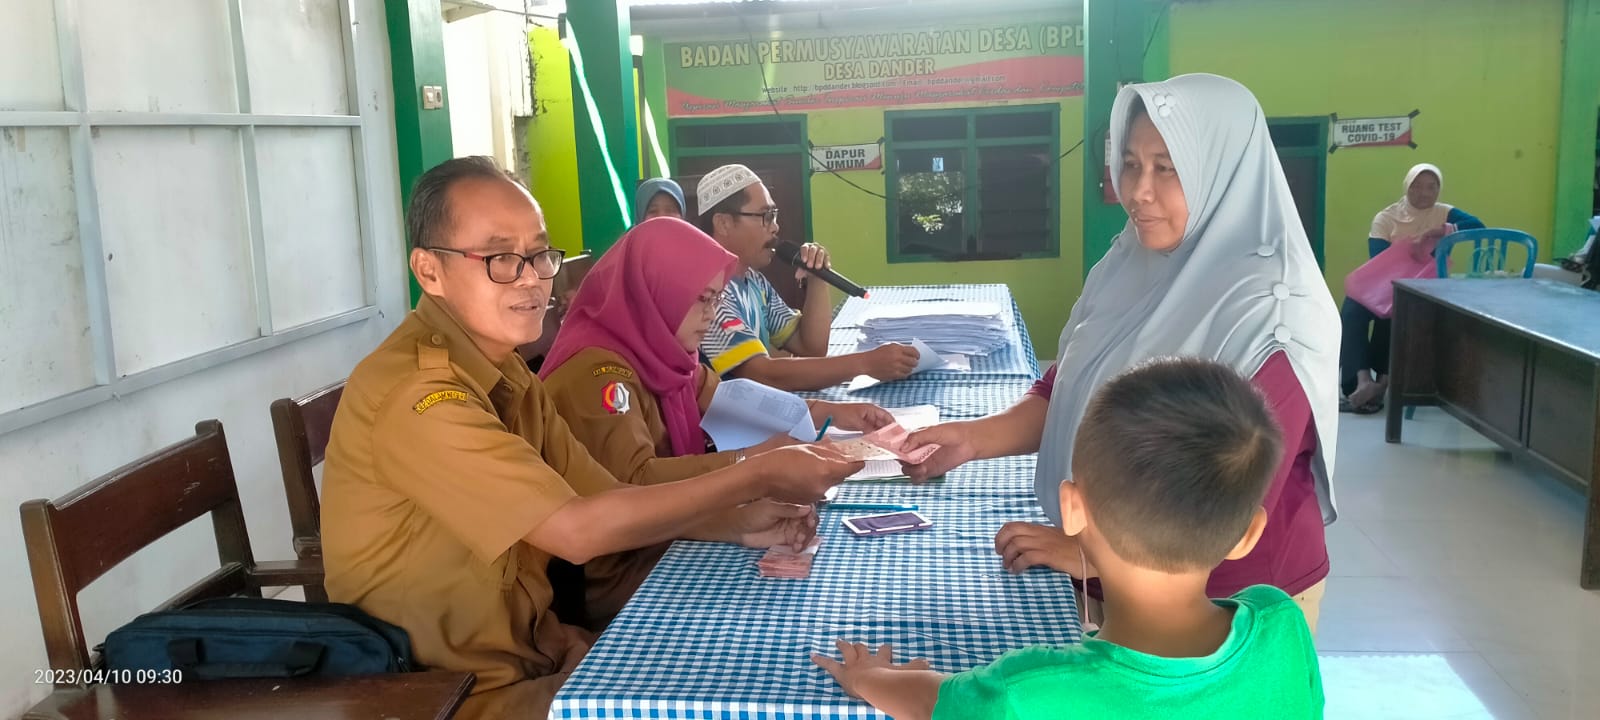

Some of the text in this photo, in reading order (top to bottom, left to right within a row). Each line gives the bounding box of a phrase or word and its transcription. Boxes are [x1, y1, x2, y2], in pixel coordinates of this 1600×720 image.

[680, 43, 750, 68] BADAN
[757, 29, 971, 64] PERMUSYAWARATAN
[978, 25, 1032, 52] DESA
[824, 58, 936, 81] DESA DANDER
[1342, 122, 1402, 133] RUANG TEST
[1347, 133, 1396, 143] COVID-19
[825, 148, 866, 159] DAPUR
[826, 159, 865, 170] UMUM
